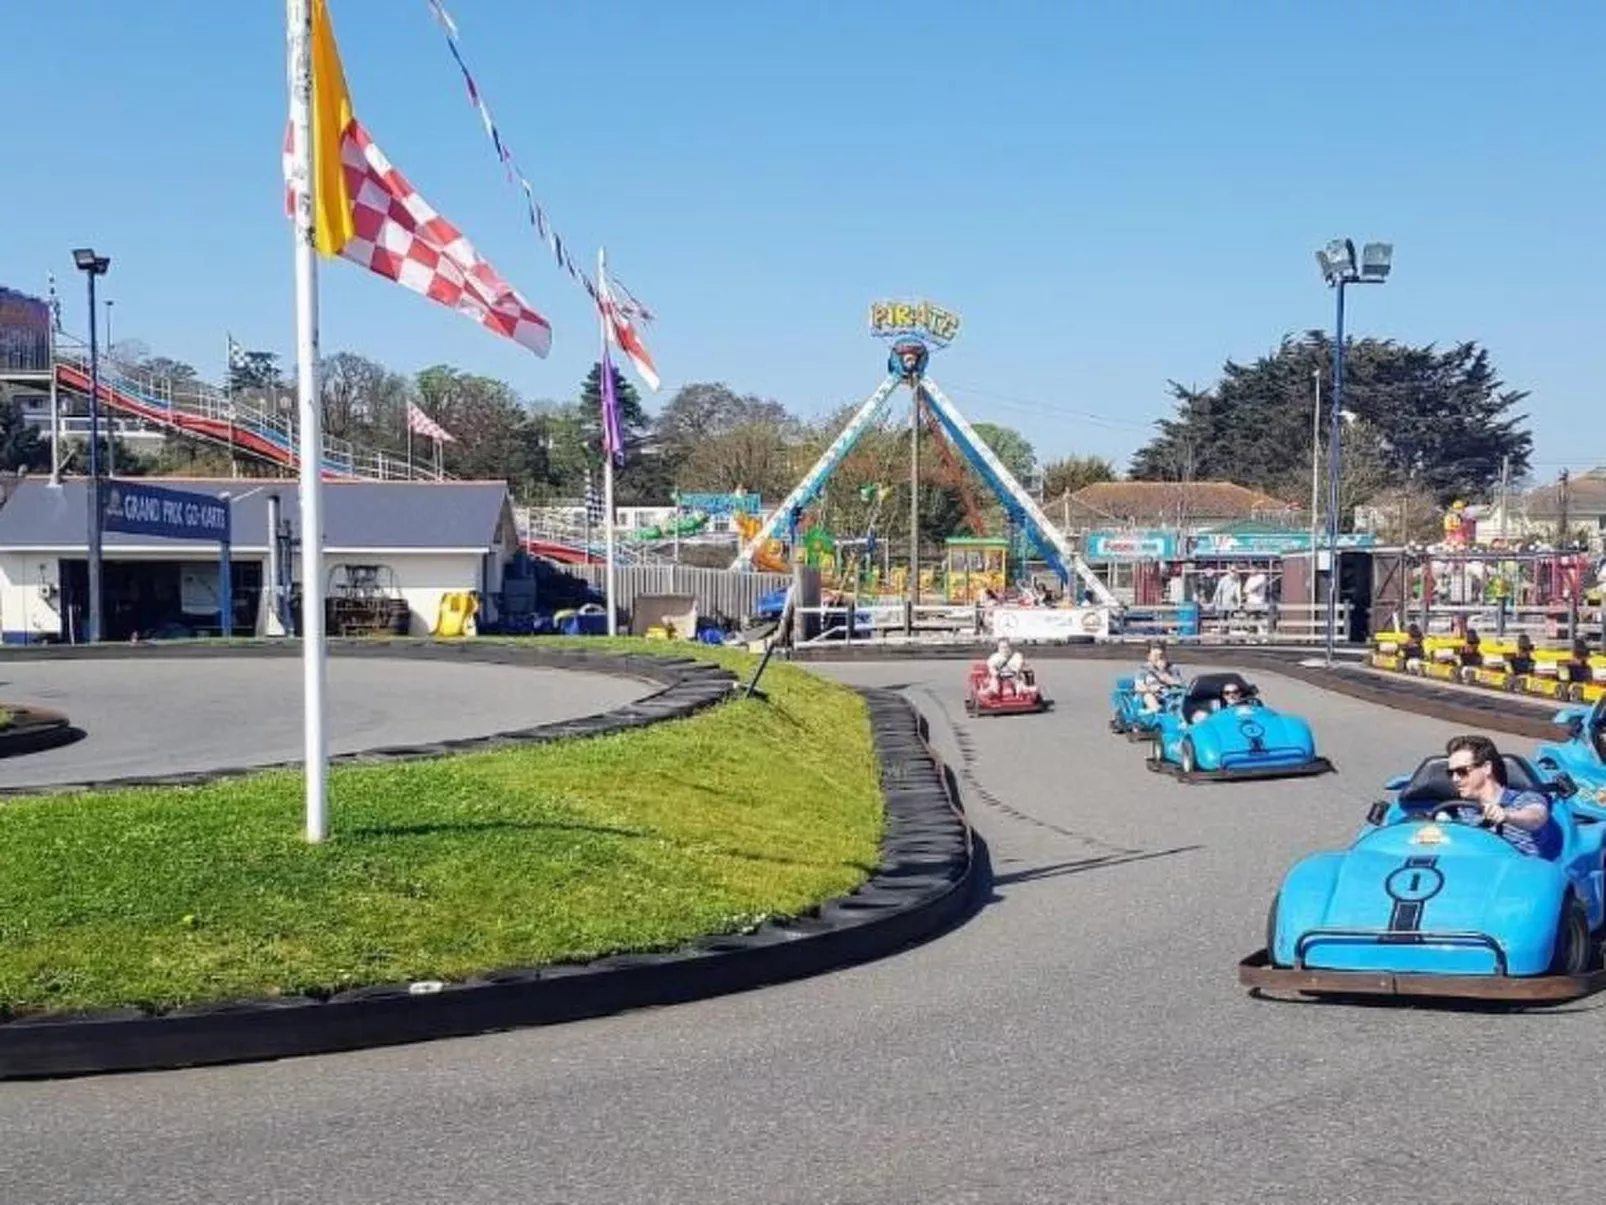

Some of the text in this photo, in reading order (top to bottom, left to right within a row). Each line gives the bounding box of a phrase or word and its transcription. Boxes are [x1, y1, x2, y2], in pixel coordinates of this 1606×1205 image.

[871, 301, 959, 341] PIRATE
[125, 495, 225, 529] GRAND PRIX GO-KARTS
